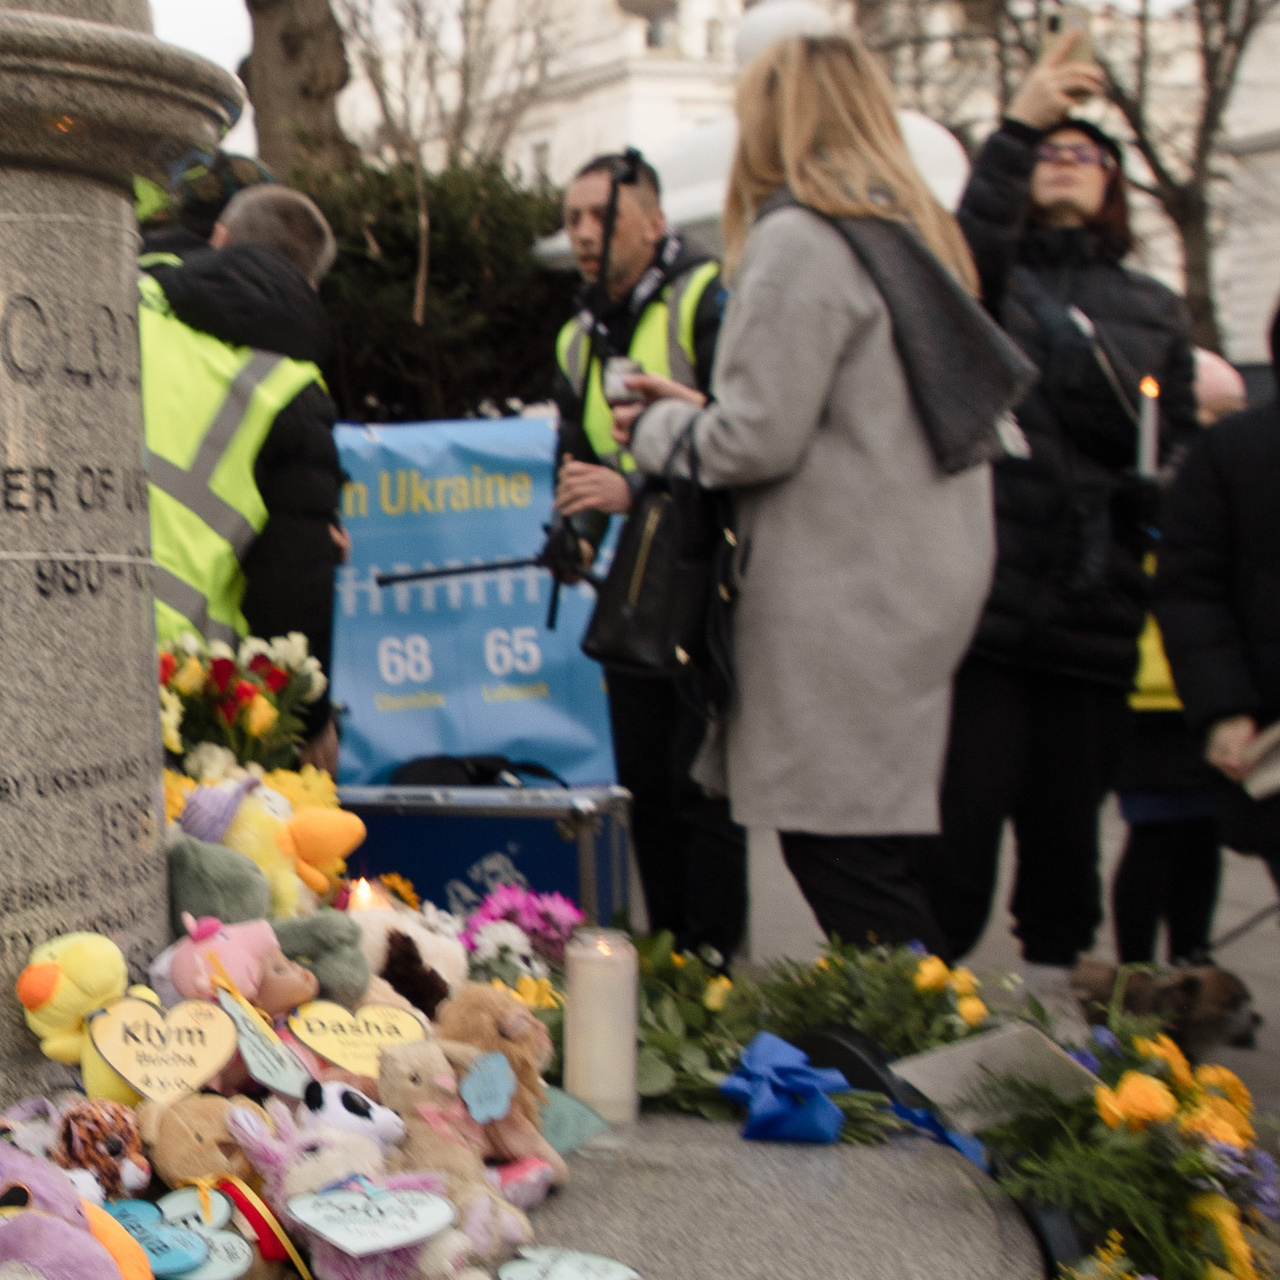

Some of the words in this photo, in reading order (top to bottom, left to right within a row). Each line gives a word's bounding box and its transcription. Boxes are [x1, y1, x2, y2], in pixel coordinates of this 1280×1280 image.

[75, 464, 114, 510] OF
[343, 478, 368, 517] n
[378, 466, 533, 516] Ukraine
[377, 634, 433, 685] 68
[483, 626, 542, 676] 65
[122, 1019, 206, 1051] Klym
[304, 1017, 403, 1038] Dasha
